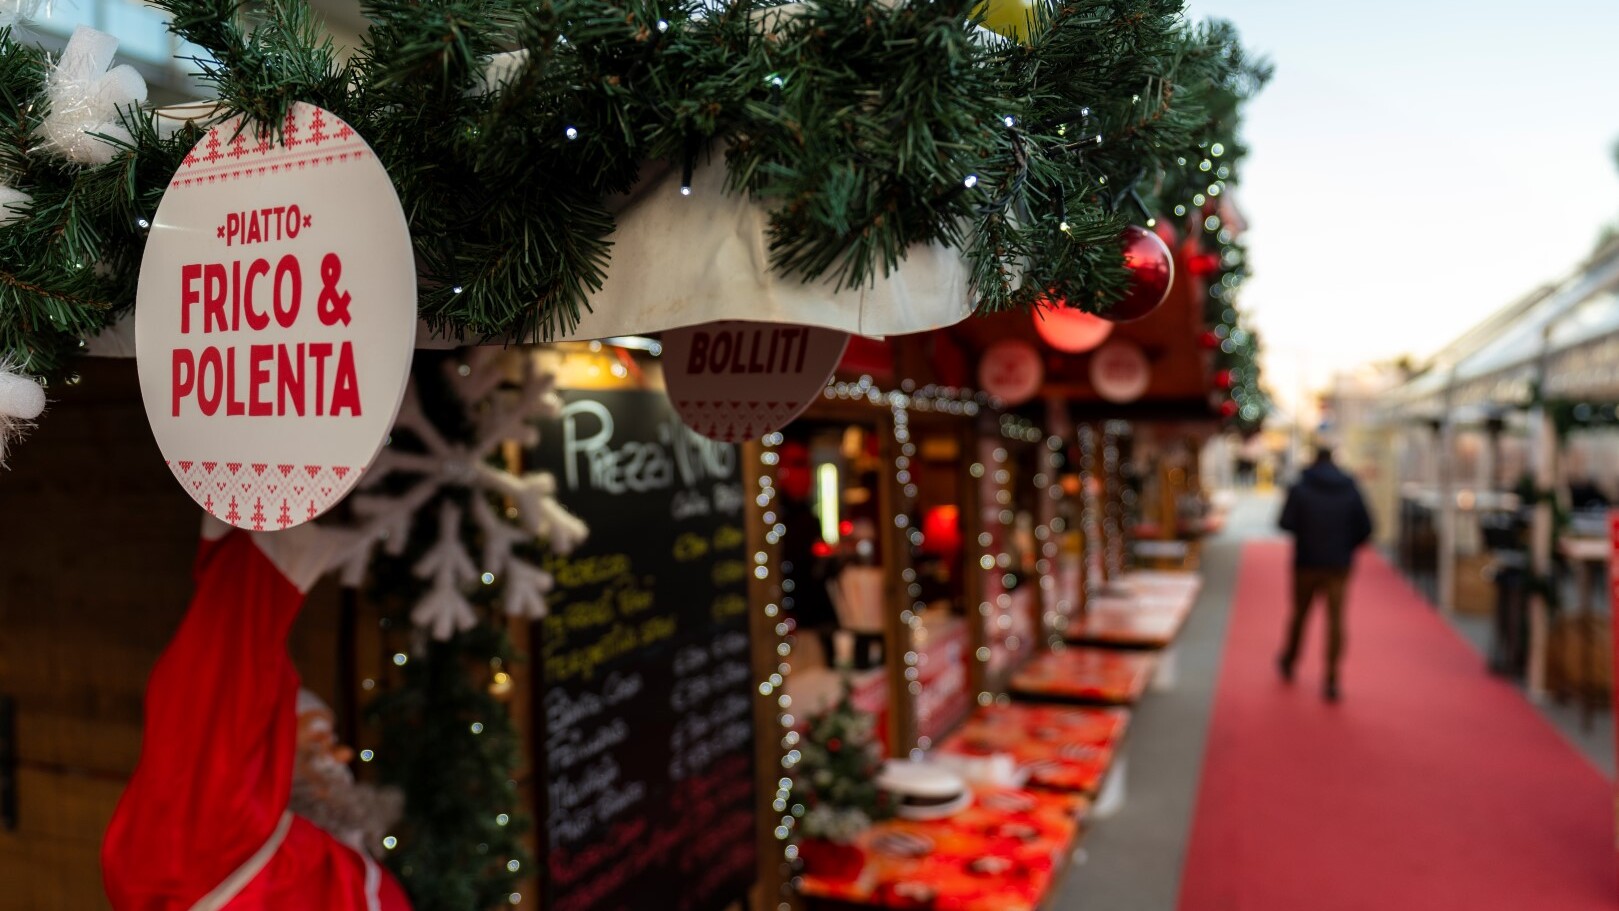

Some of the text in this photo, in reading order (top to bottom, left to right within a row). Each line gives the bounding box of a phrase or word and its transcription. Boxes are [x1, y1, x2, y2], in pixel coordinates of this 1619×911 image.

[226, 204, 301, 246] PIATTO
[180, 252, 352, 334] FRICO &
[172, 340, 362, 417] POLENTA
[687, 326, 810, 375] BOLLITI
